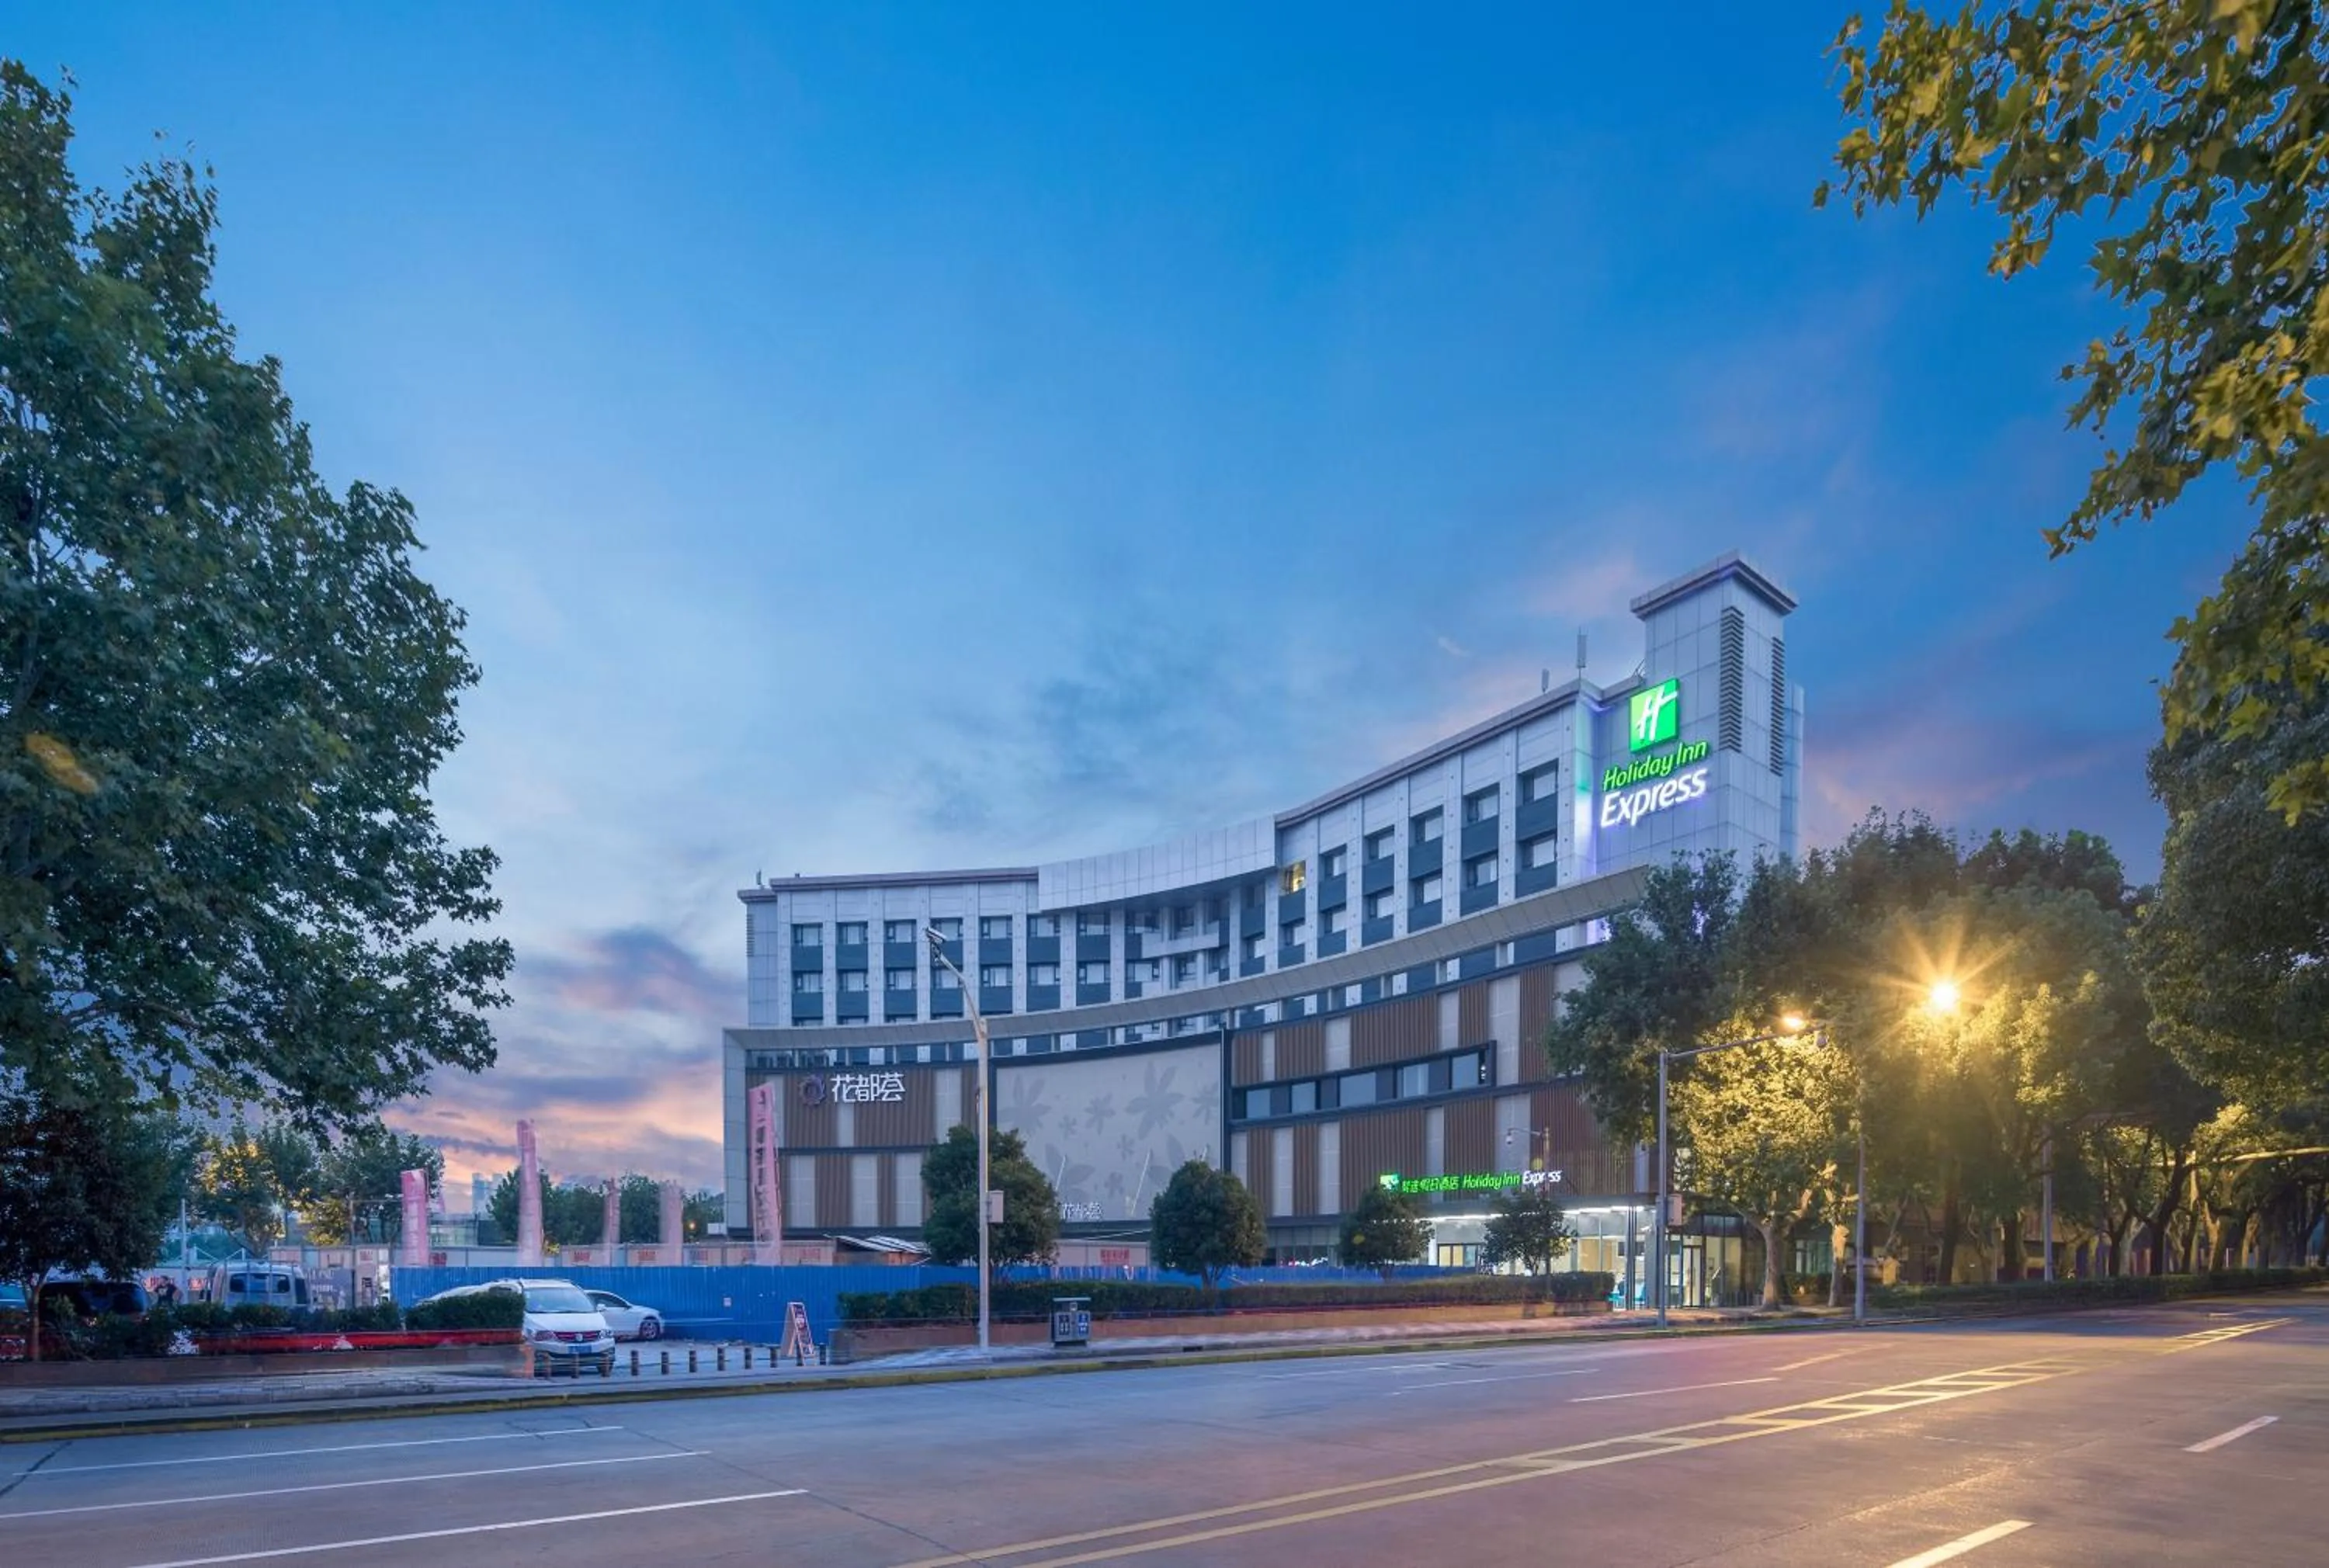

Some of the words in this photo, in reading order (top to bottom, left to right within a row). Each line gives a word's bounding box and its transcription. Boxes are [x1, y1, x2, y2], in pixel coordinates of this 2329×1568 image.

[1602, 754, 1673, 792] Holiday
[1677, 741, 1708, 765] Inn
[1600, 768, 1708, 829] Express
[830, 1072, 906, 1102] 花都荟
[1463, 1172, 1501, 1190] Holiday
[1502, 1171, 1520, 1185] Inn
[1522, 1170, 1562, 1187] Exprss
